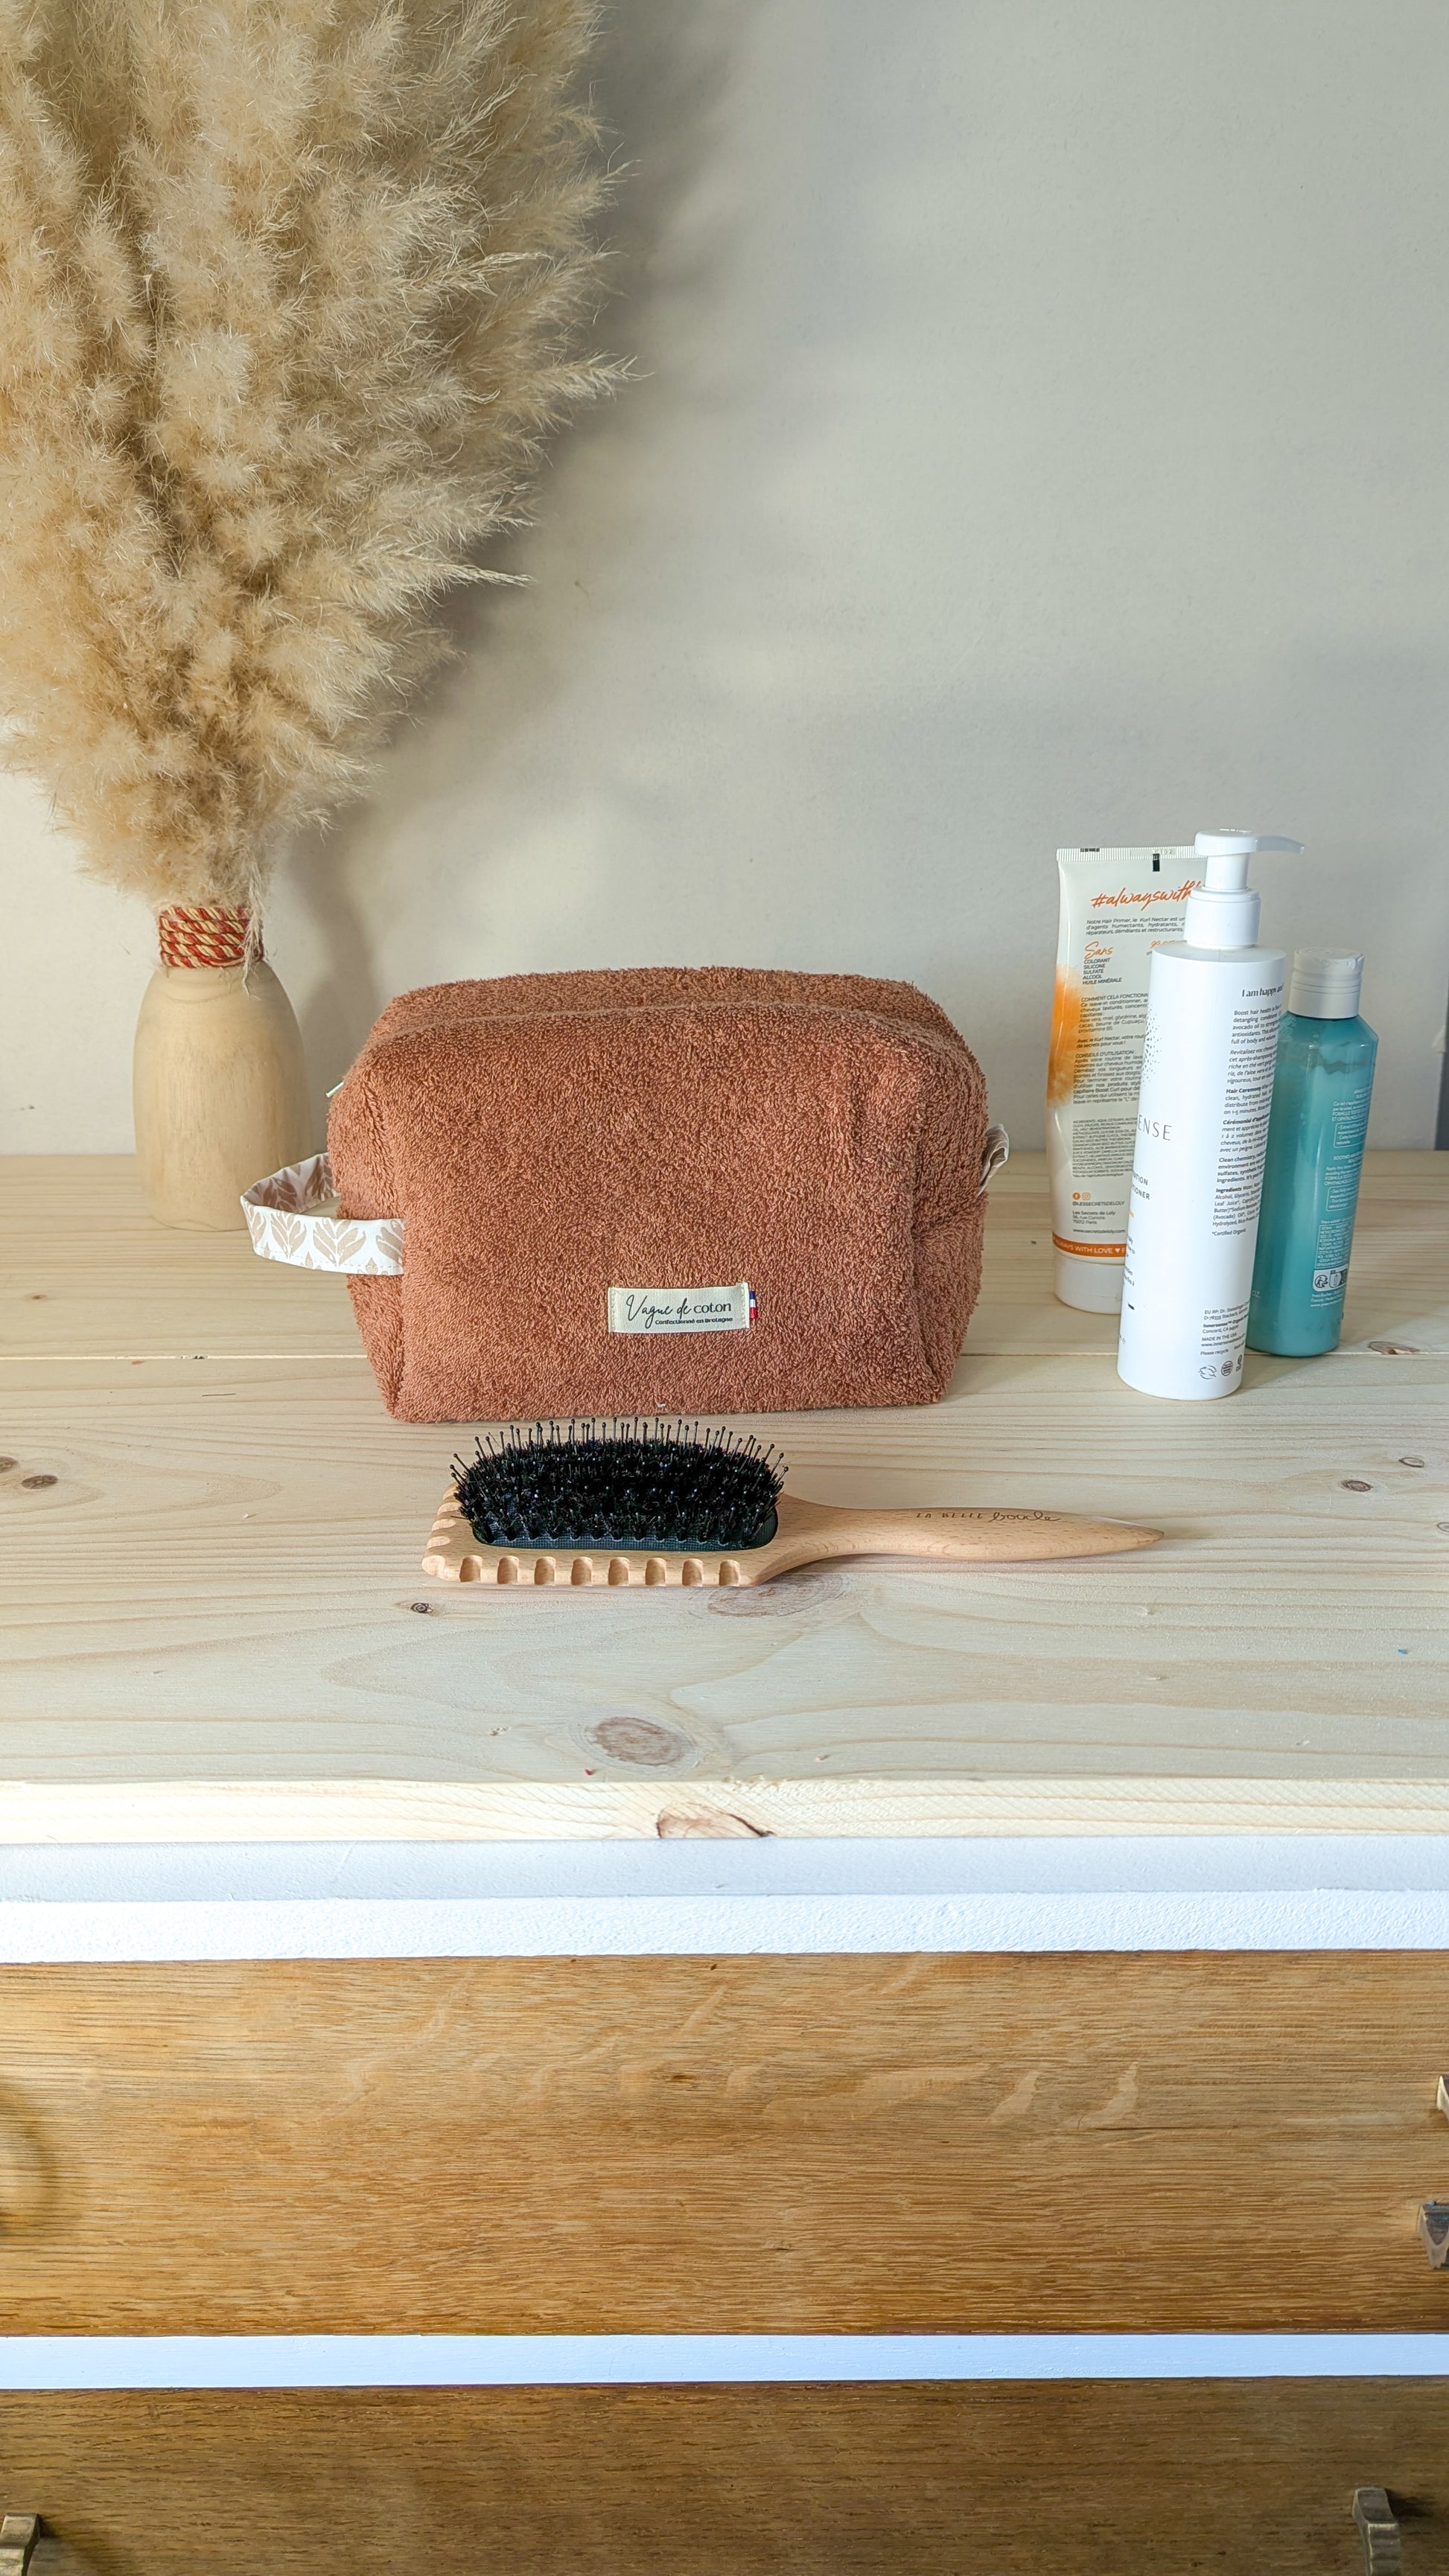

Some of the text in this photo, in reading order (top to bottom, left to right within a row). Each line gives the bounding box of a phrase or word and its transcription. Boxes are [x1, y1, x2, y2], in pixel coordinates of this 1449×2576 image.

[1084, 941, 1113, 960] Sans
[626, 1294, 731, 1329] Vague de coton
